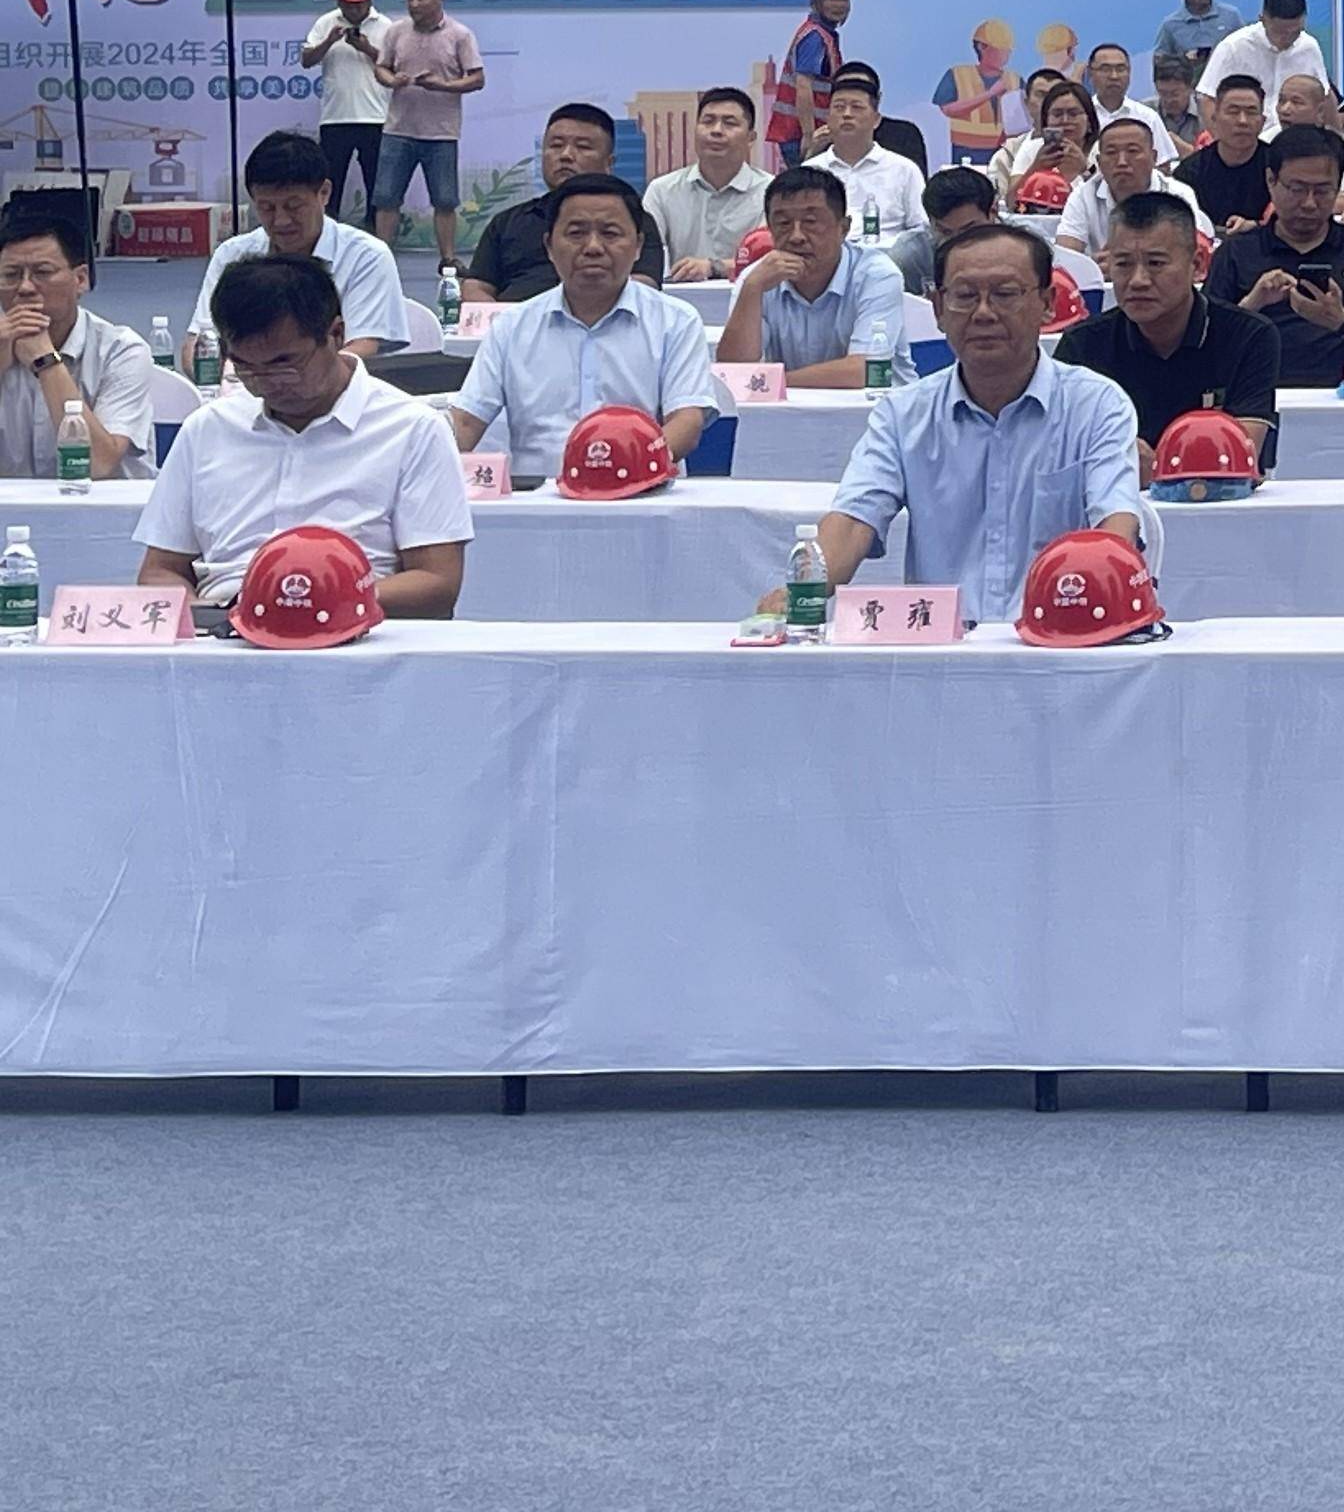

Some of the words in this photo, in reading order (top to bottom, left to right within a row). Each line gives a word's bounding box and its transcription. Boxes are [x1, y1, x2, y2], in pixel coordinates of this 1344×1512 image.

[60, 599, 172, 635] 刘义军
[858, 597, 935, 632] 贾雍
